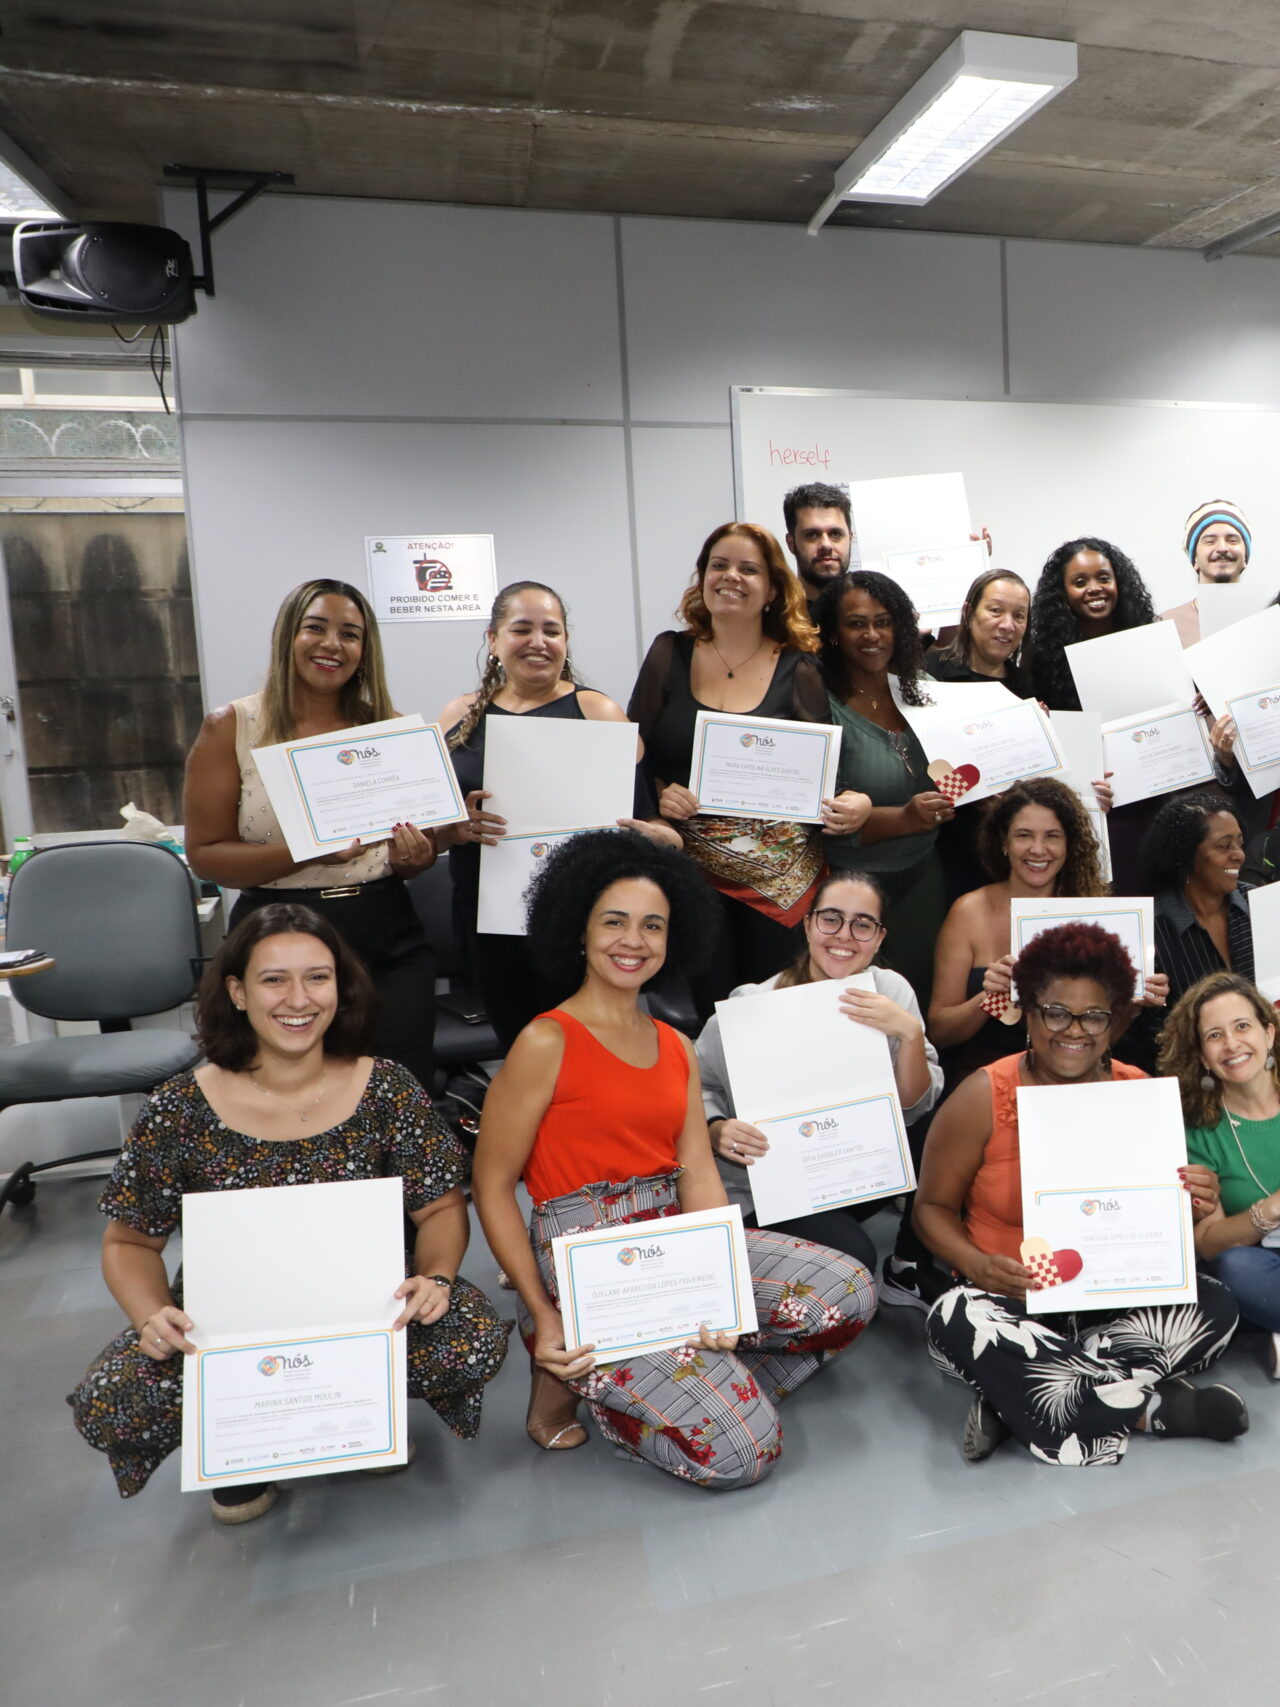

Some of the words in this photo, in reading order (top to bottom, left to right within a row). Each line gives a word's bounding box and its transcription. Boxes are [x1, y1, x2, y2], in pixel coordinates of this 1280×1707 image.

[768, 439, 831, 471] herself
[407, 541, 454, 551] ATENÇÃO!
[390, 595, 435, 604] PROIBIDO
[437, 594, 471, 602] COMER
[389, 605, 421, 614] BEBER
[424, 604, 454, 613] NESTA
[753, 735, 776, 748] nós
[353, 746, 381, 760] nós
[352, 779, 377, 789] DANIELA
[815, 1117, 839, 1132] nós
[1097, 1199, 1123, 1212] nós
[636, 1244, 666, 1260] nós
[621, 1283, 657, 1295] APARECIDA
[657, 1280, 678, 1290] LOPES
[678, 1273, 716, 1286] FIGUEIREDO
[277, 1353, 314, 1371] nós
[254, 1398, 282, 1409] MARINA
[284, 1394, 313, 1406] SANTOS
[314, 1391, 342, 1403] MOULIN
